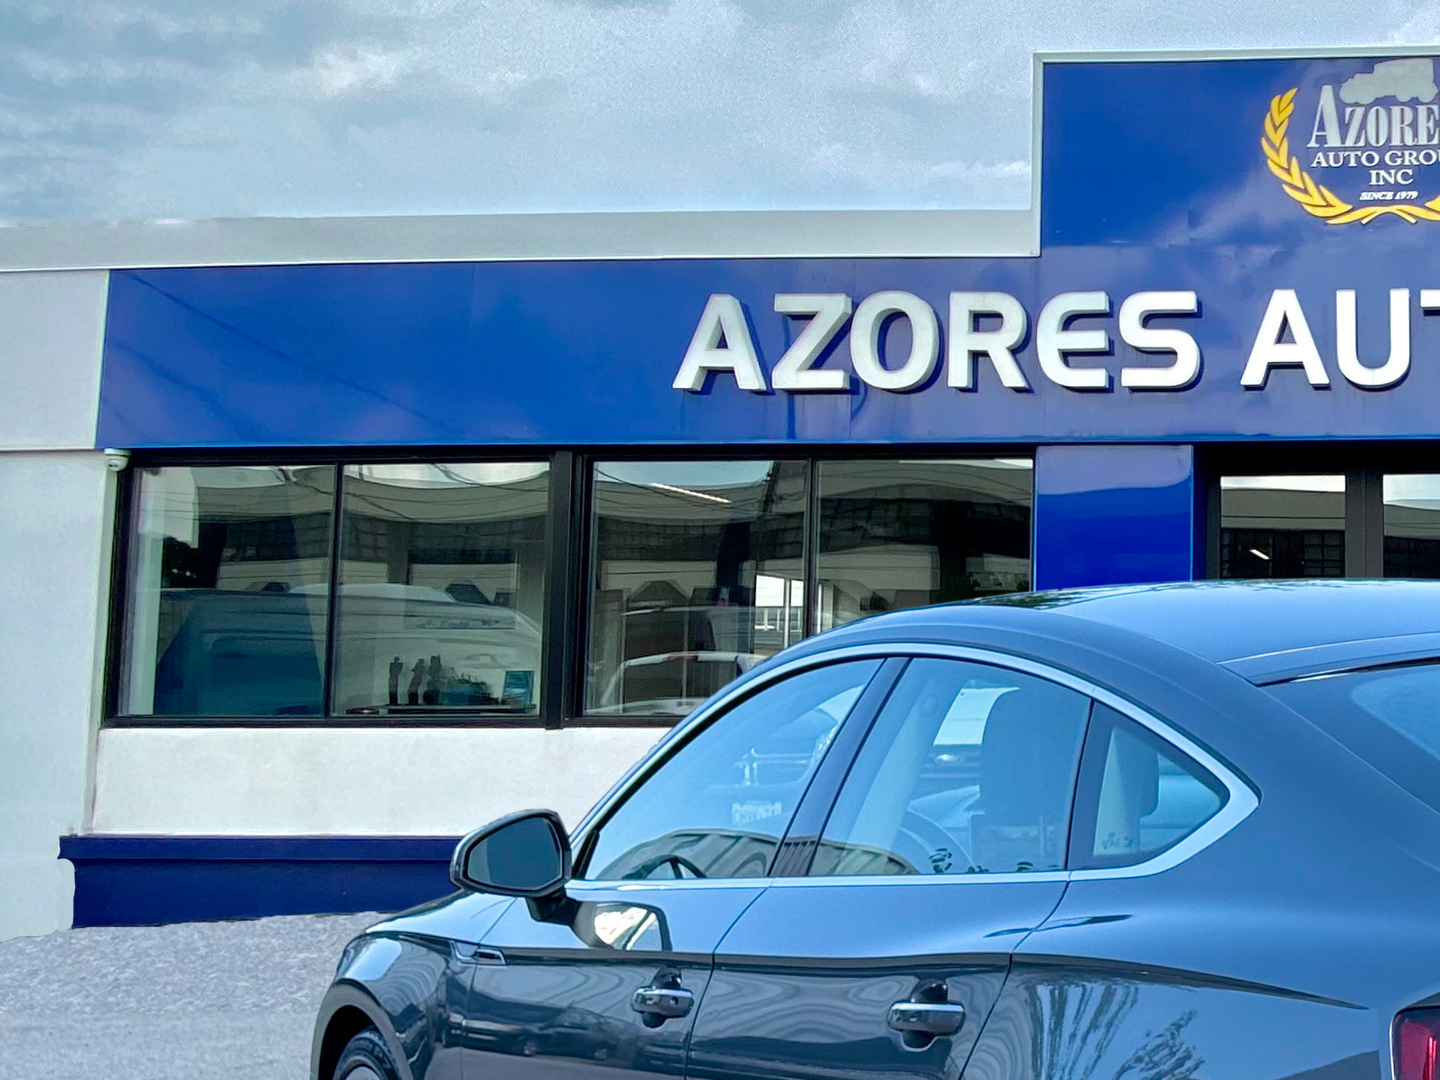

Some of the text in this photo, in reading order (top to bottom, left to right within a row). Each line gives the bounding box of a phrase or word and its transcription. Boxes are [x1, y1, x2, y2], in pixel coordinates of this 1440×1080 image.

[1311, 151, 1379, 168] AUTO
[1369, 169, 1413, 186] INC
[1359, 190, 1418, 201] SINCE 1979
[672, 290, 1202, 393] AZORES
